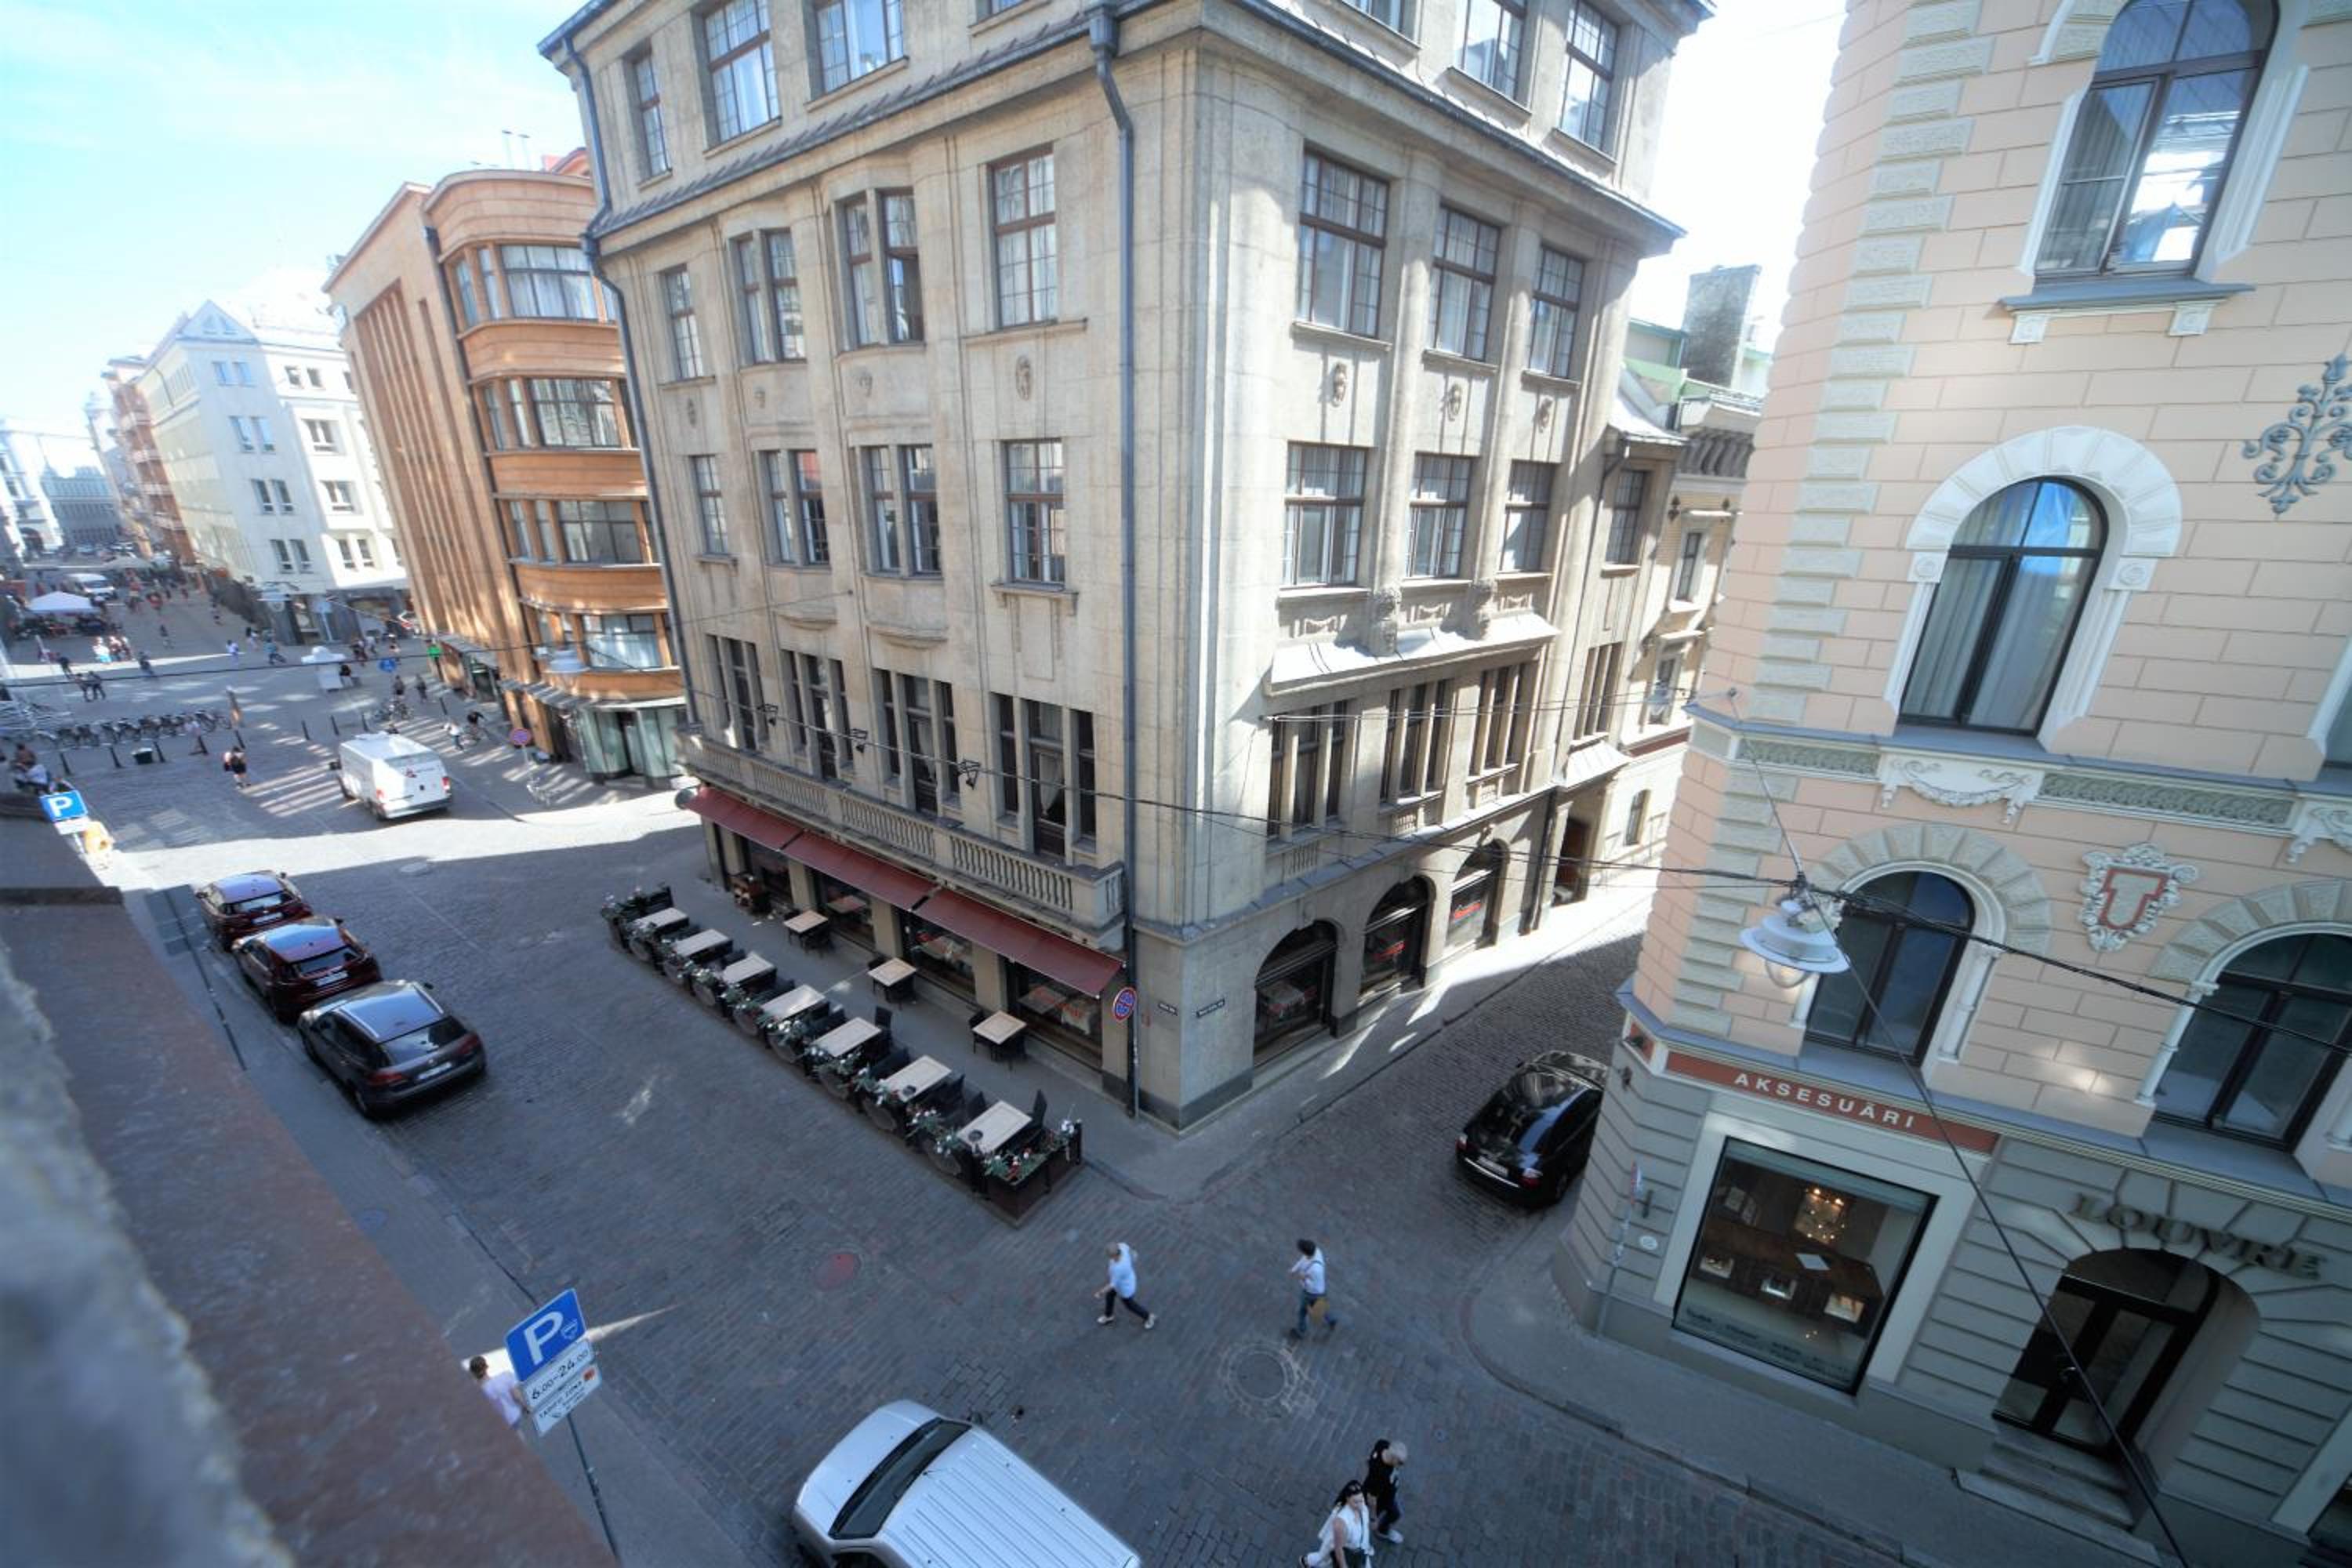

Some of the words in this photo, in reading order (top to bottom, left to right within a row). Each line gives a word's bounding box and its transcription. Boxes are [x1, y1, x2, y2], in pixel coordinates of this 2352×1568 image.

[48, 797, 74, 817] P
[1734, 1073, 1915, 1128] AKSESUĀRI
[524, 1311, 564, 1366] P
